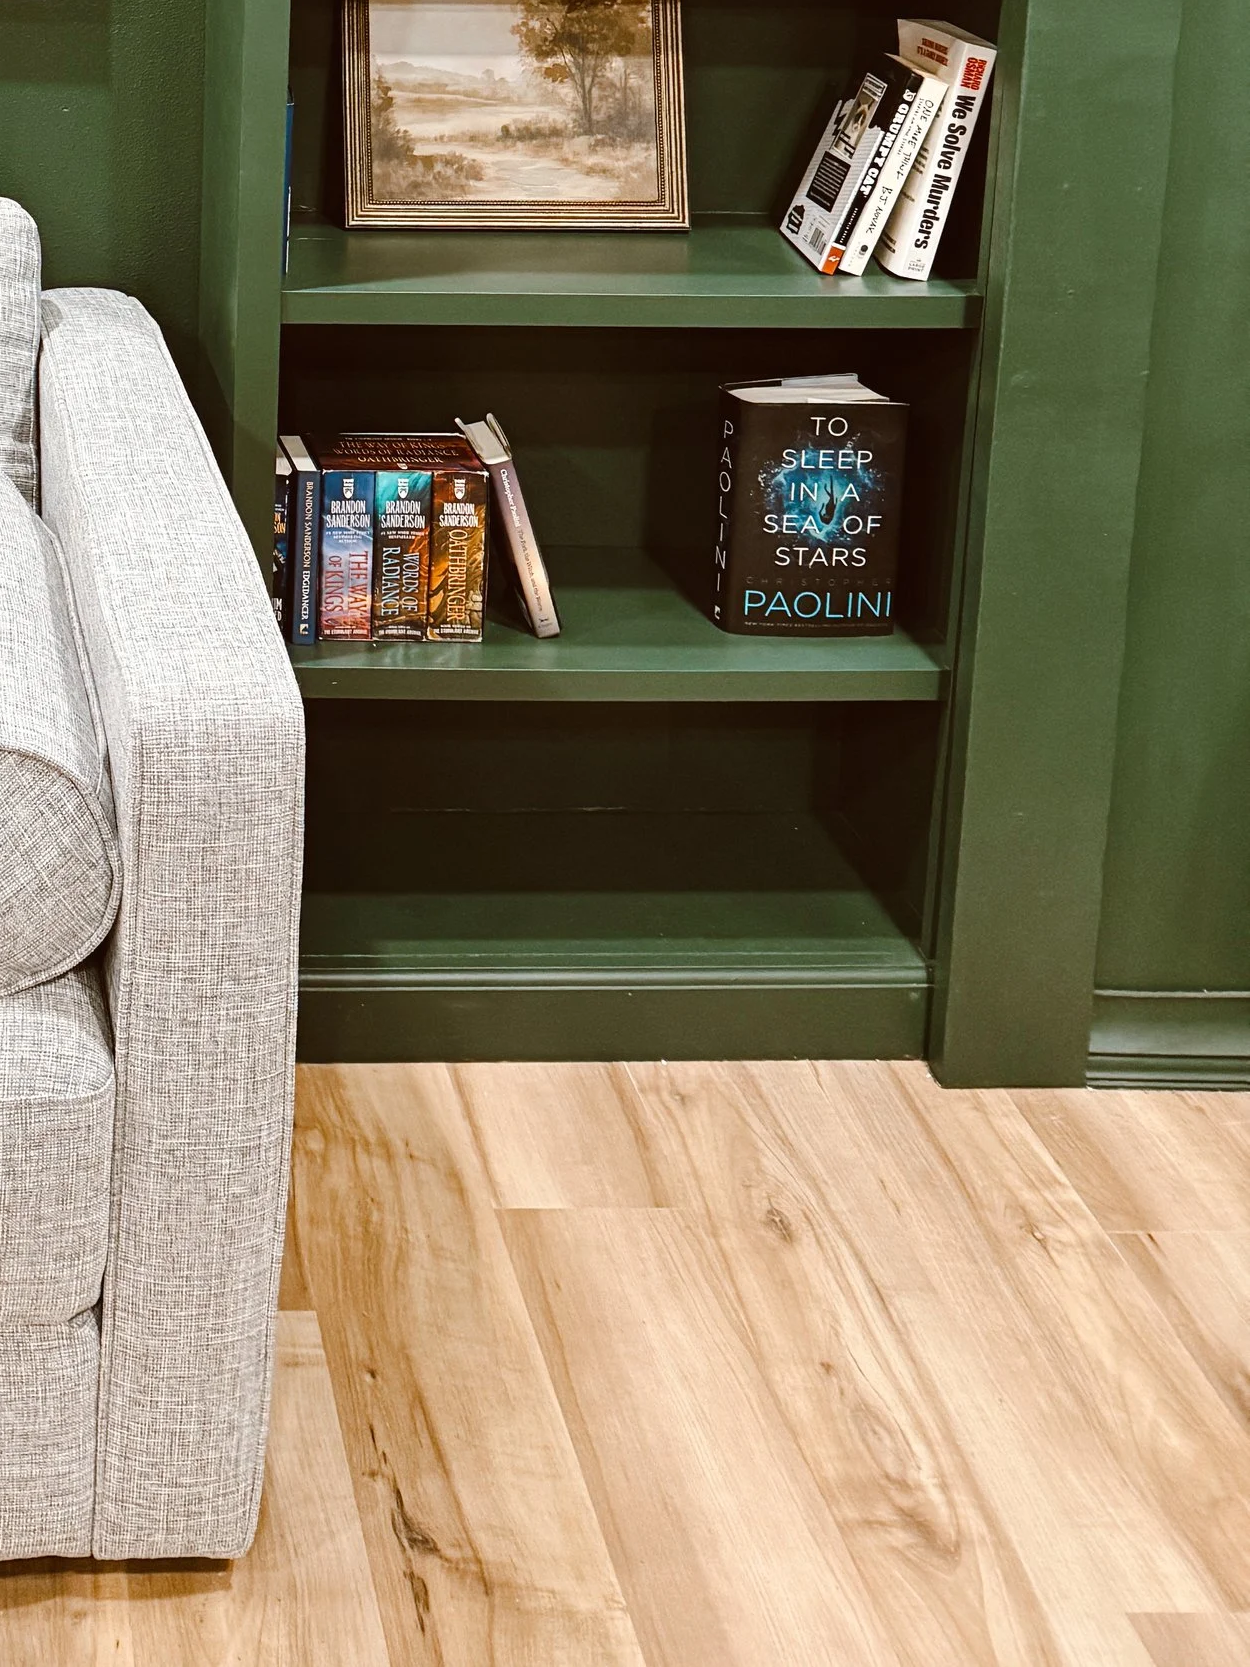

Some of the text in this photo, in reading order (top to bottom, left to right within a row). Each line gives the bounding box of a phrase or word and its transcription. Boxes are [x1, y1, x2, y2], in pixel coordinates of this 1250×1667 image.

[960, 57, 978, 89] OSMAN
[969, 59, 987, 91] RICHARD
[920, 99, 935, 123] ONE
[951, 95, 976, 120] We
[873, 103, 910, 168] GRUMPY
[937, 122, 967, 171] Solve
[860, 167, 879, 197] CAT
[865, 205, 884, 234] NOVAK
[914, 173, 950, 251] Murders
[810, 416, 849, 437] TO
[364, 441, 389, 449] WAY
[409, 442, 447, 450] KINGS
[781, 449, 873, 470] SLEEP
[714, 419, 734, 592] PAOLINI
[790, 482, 861, 502] IN A
[326, 514, 371, 528] SANDERSON
[330, 500, 366, 514] BRANDON
[385, 500, 421, 515] BRANDON
[439, 515, 479, 528] SANDERSON
[443, 502, 475, 515] BRANDON
[381, 515, 426, 529] SANDERSON
[762, 514, 882, 534] SEA OF
[301, 481, 314, 621] BRANDON SANDERSON EDGEDANCER
[774, 546, 867, 567] STARS
[324, 555, 344, 613] OF KINGS
[348, 550, 369, 617] THE WAY
[381, 546, 401, 617] RADIANCE
[401, 552, 420, 612] WORDS OF
[447, 529, 468, 622] OATHBRINGER
[744, 589, 891, 618] PAOLINI
